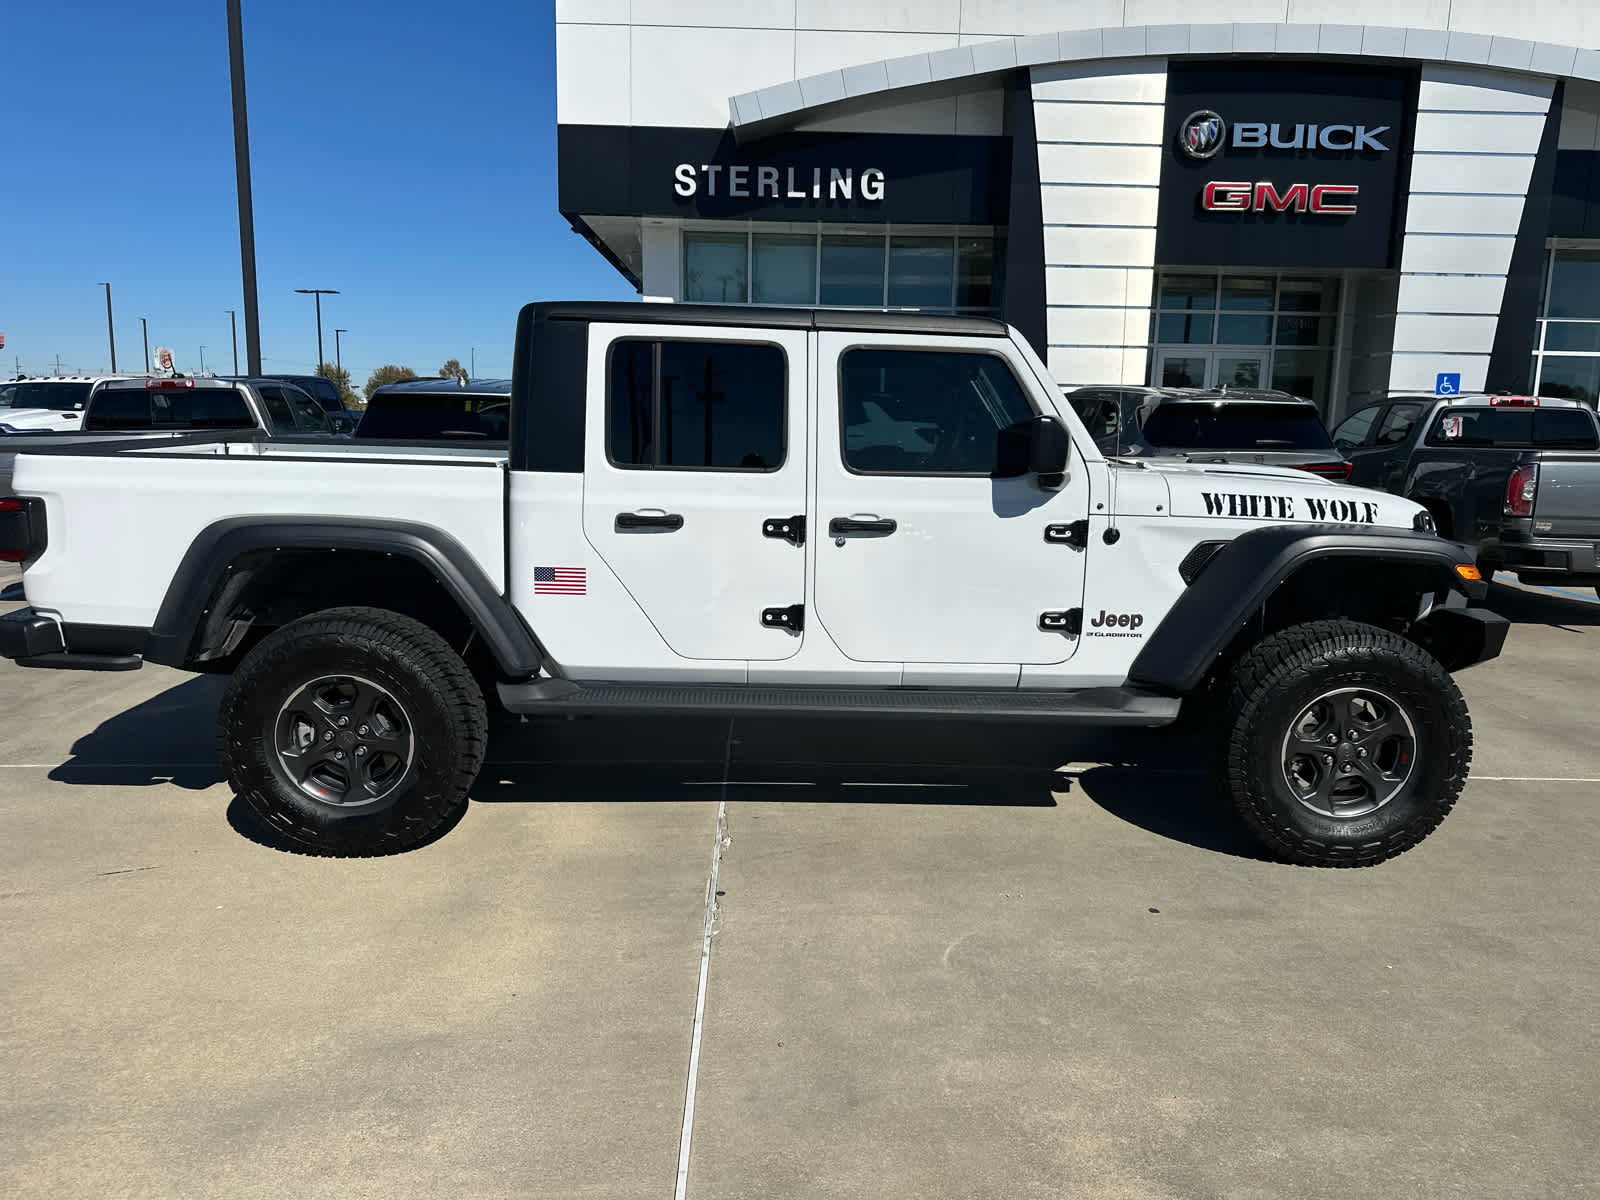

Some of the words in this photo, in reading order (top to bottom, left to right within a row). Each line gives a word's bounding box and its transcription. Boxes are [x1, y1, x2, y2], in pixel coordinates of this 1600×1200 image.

[1232, 122, 1391, 151] BUICK
[674, 163, 885, 200] STERLING
[1202, 180, 1359, 214] GMC
[1200, 492, 1295, 519] WHITE
[1304, 497, 1378, 523] WOLF
[1091, 609, 1143, 630] Jeep
